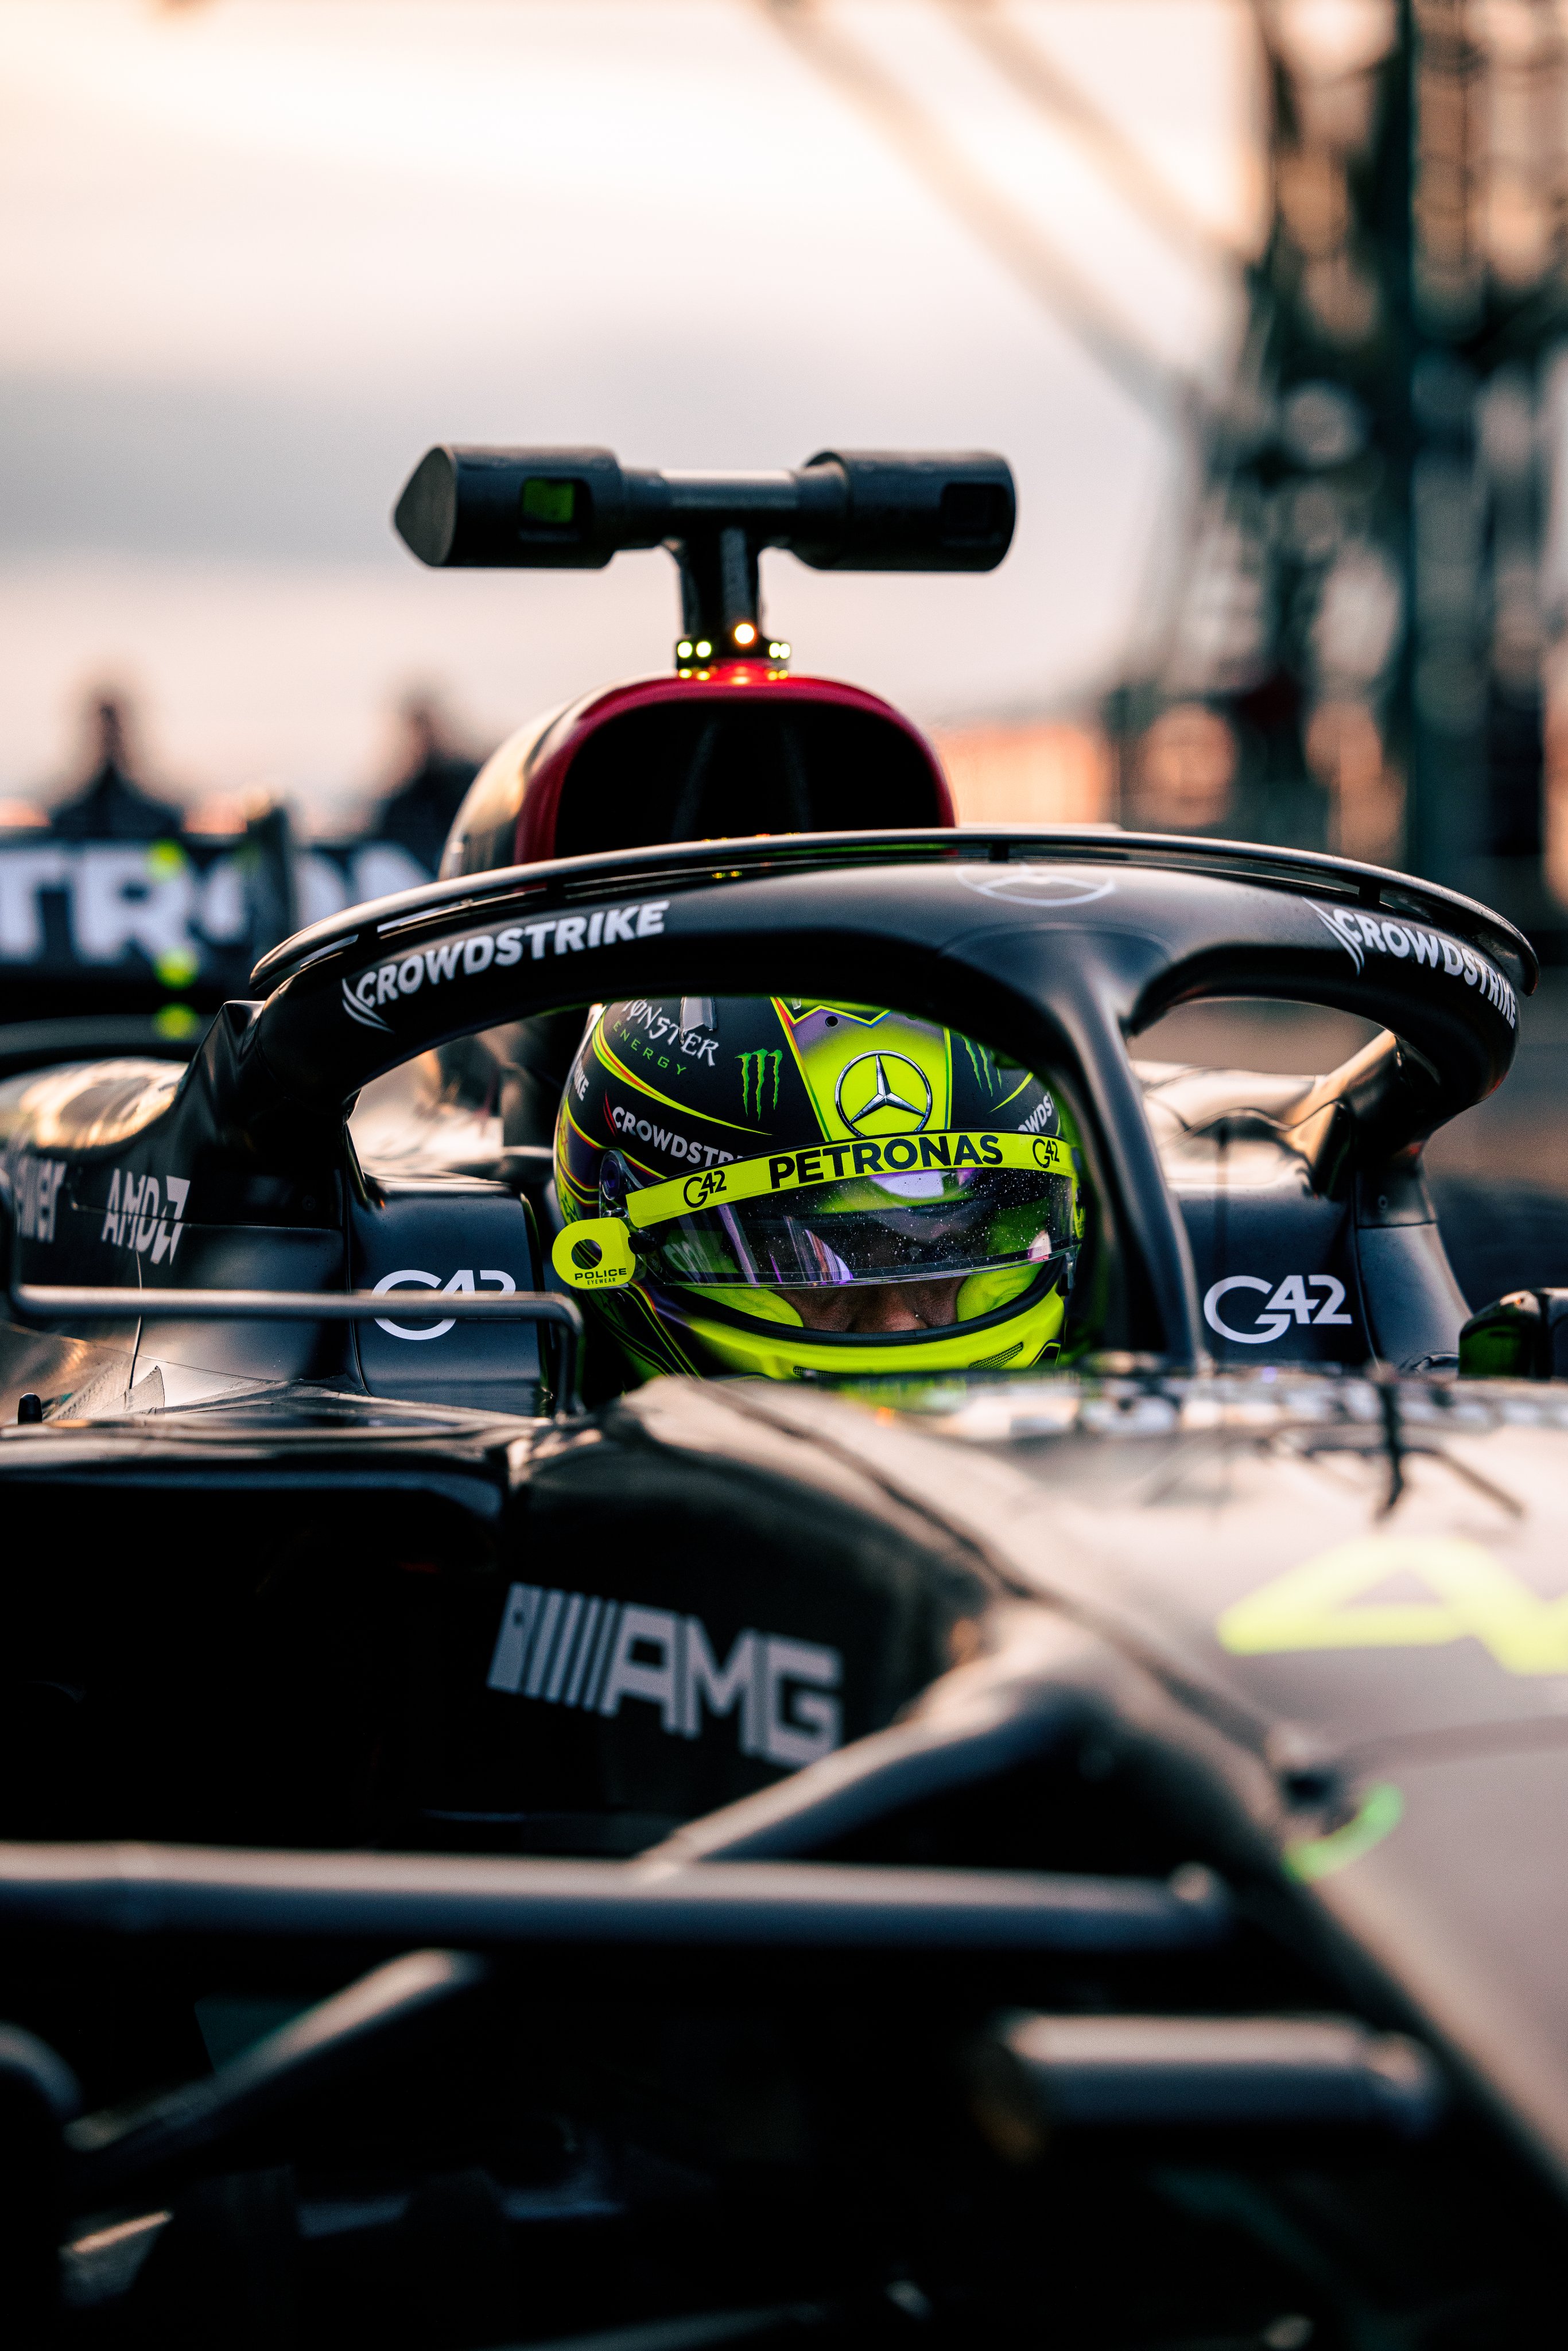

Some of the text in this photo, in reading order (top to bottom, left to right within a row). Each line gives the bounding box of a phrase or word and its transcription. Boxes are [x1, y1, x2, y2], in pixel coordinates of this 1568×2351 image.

[356, 900, 670, 1008] CROWDSTRIKE
[1333, 908, 1516, 1029] CROWDSTRIKE
[612, 1021, 687, 1075] ENERGY
[683, 1134, 1060, 1208] G42 PETRONAS G42
[101, 1167, 161, 1253] AMD
[575, 1267, 627, 1281] POLICE
[587, 1277, 616, 1285] EYEWEAR
[1203, 1274, 1353, 1344] G42
[596, 1600, 845, 1771] AMG
